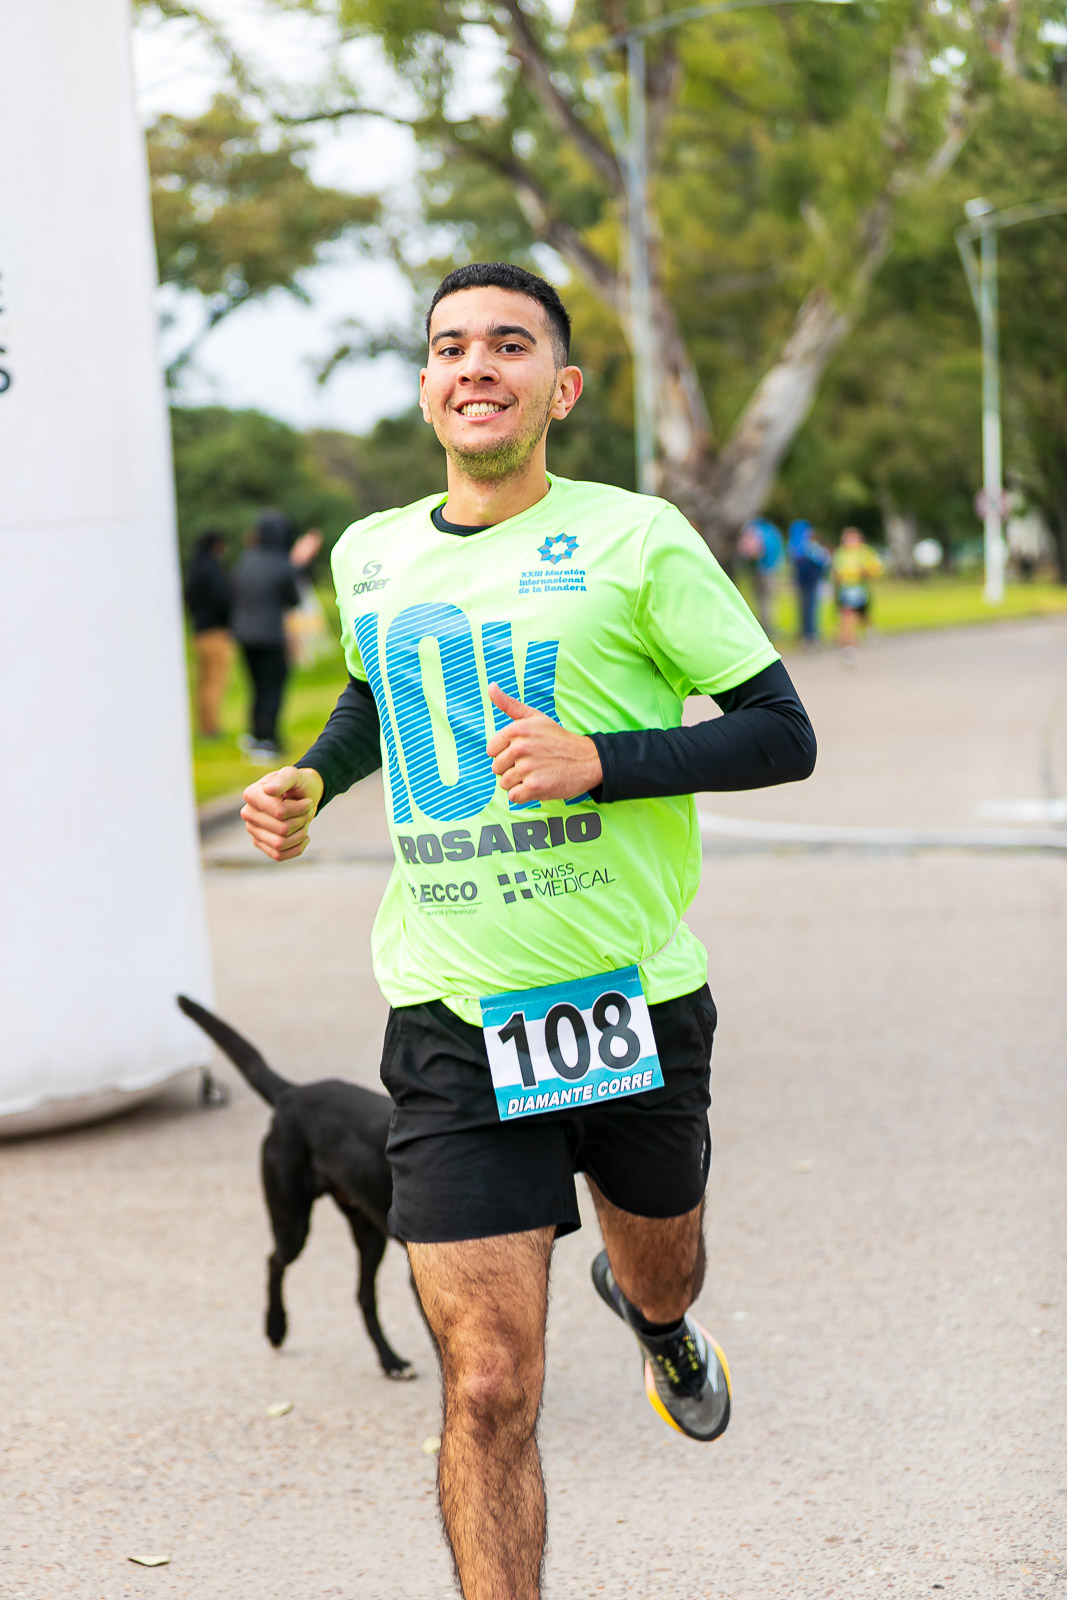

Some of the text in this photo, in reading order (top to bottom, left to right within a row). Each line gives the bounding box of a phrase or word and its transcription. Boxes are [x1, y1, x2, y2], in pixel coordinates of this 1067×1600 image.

[519, 576, 584, 586] Internacional
[545, 568, 586, 577] Maratón
[544, 584, 587, 592] Bandera
[398, 812, 602, 864] ROSARIO
[531, 863, 575, 881] SWISS
[534, 868, 616, 897] MEDICAL
[497, 990, 641, 1090] 108
[507, 1070, 653, 1115] DIAMANTE CORRE
